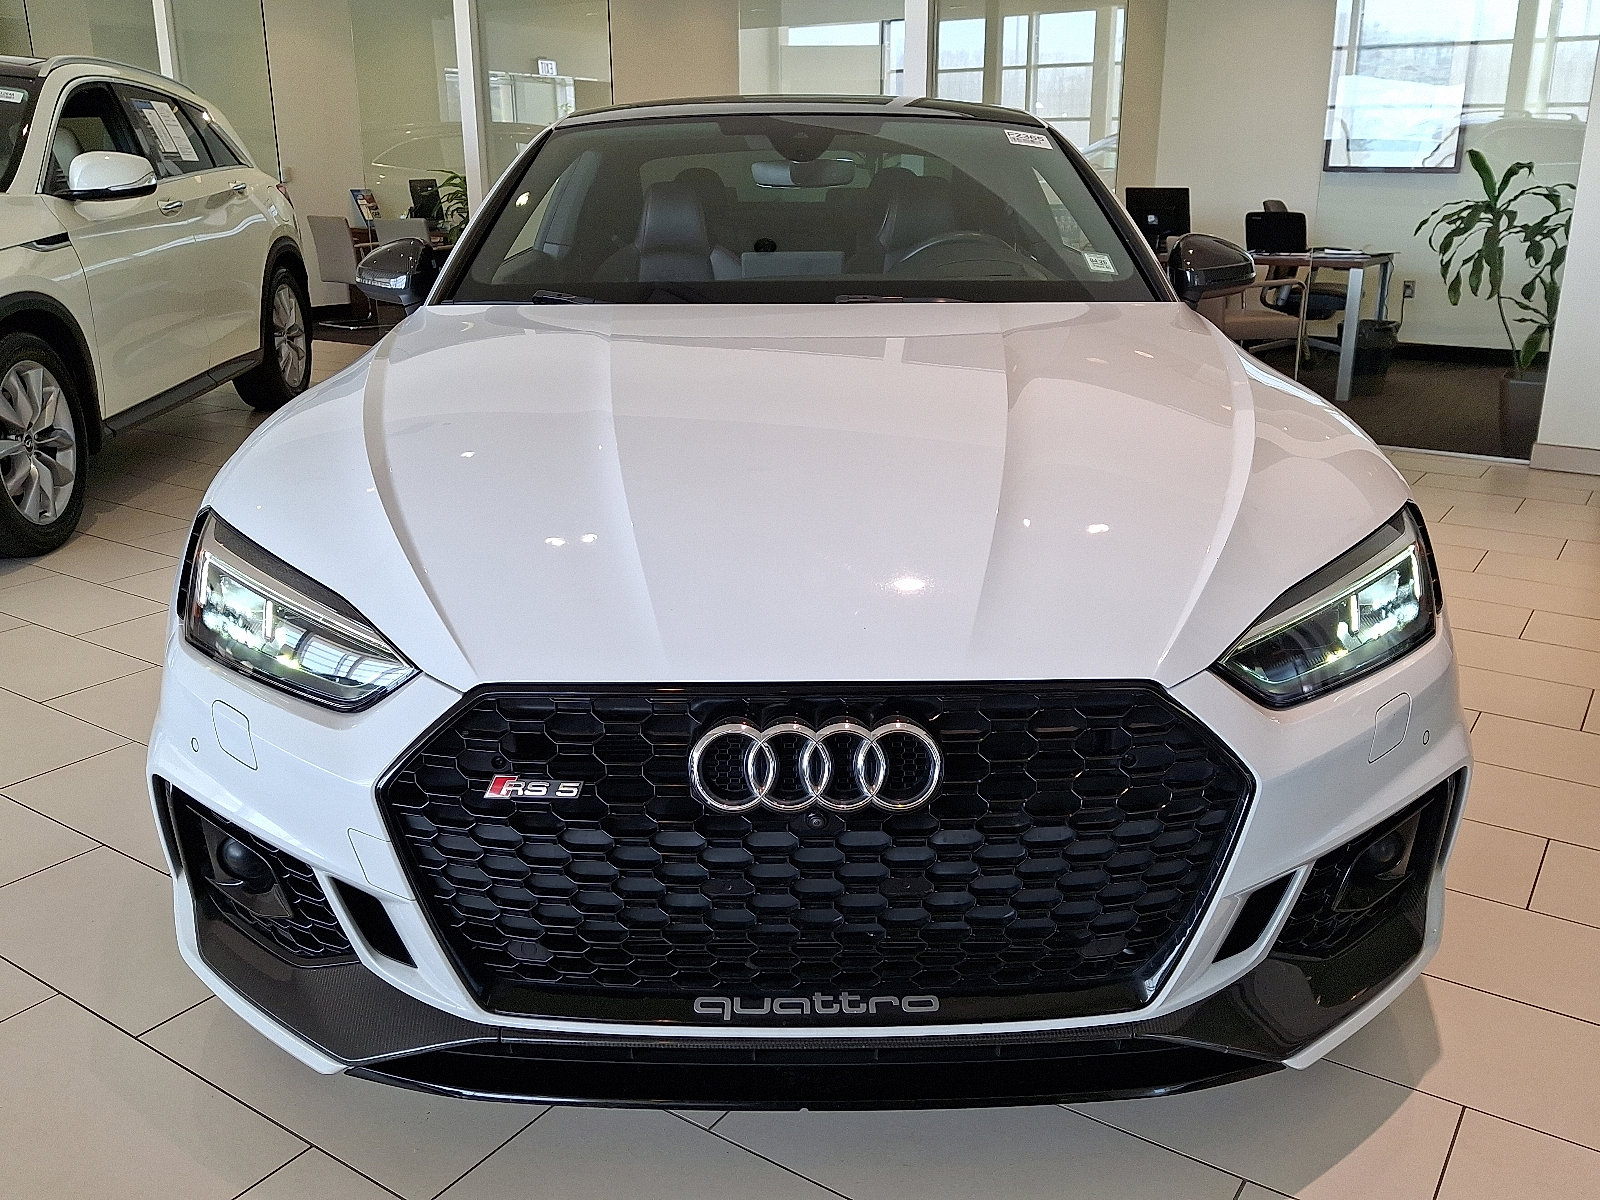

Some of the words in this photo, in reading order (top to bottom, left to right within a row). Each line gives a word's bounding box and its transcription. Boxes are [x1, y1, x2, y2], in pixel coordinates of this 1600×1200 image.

[500, 781, 550, 796] RS
[556, 782, 580, 797] 5
[693, 991, 940, 1021] quattro
